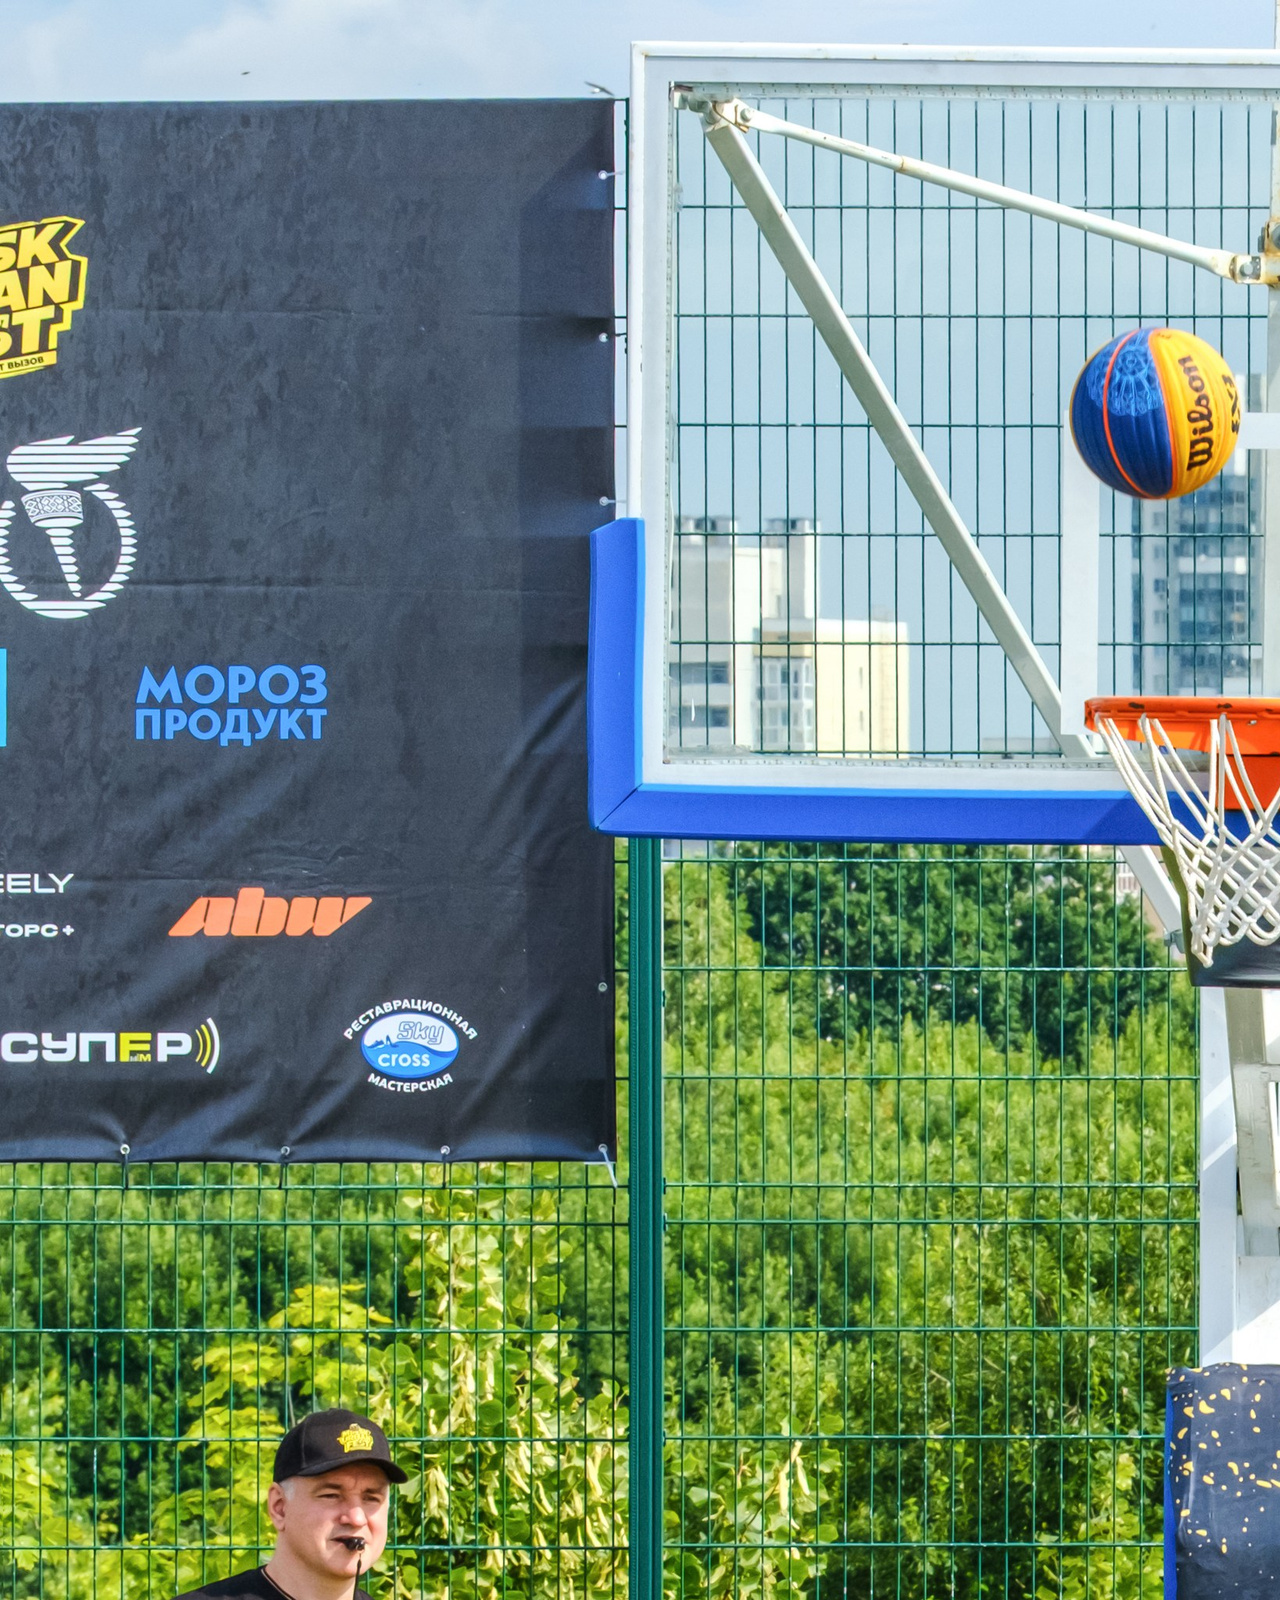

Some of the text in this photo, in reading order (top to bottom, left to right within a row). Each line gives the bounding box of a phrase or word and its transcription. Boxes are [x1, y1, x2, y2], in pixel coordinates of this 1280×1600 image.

[7, 356, 44, 369] ВЫЗОВ
[1177, 355, 1214, 472] Wilson
[136, 664, 329, 705] МОРОЗ
[135, 708, 328, 747] ПРОДУКТ
[0, 873, 75, 893] ELY
[343, 999, 478, 1040] РЕСТАВРАЦИОННАЯ
[397, 1021, 445, 1045] Sky
[377, 1053, 431, 1067] cross
[368, 1073, 453, 1092] МАСТЕРСКАЯ
